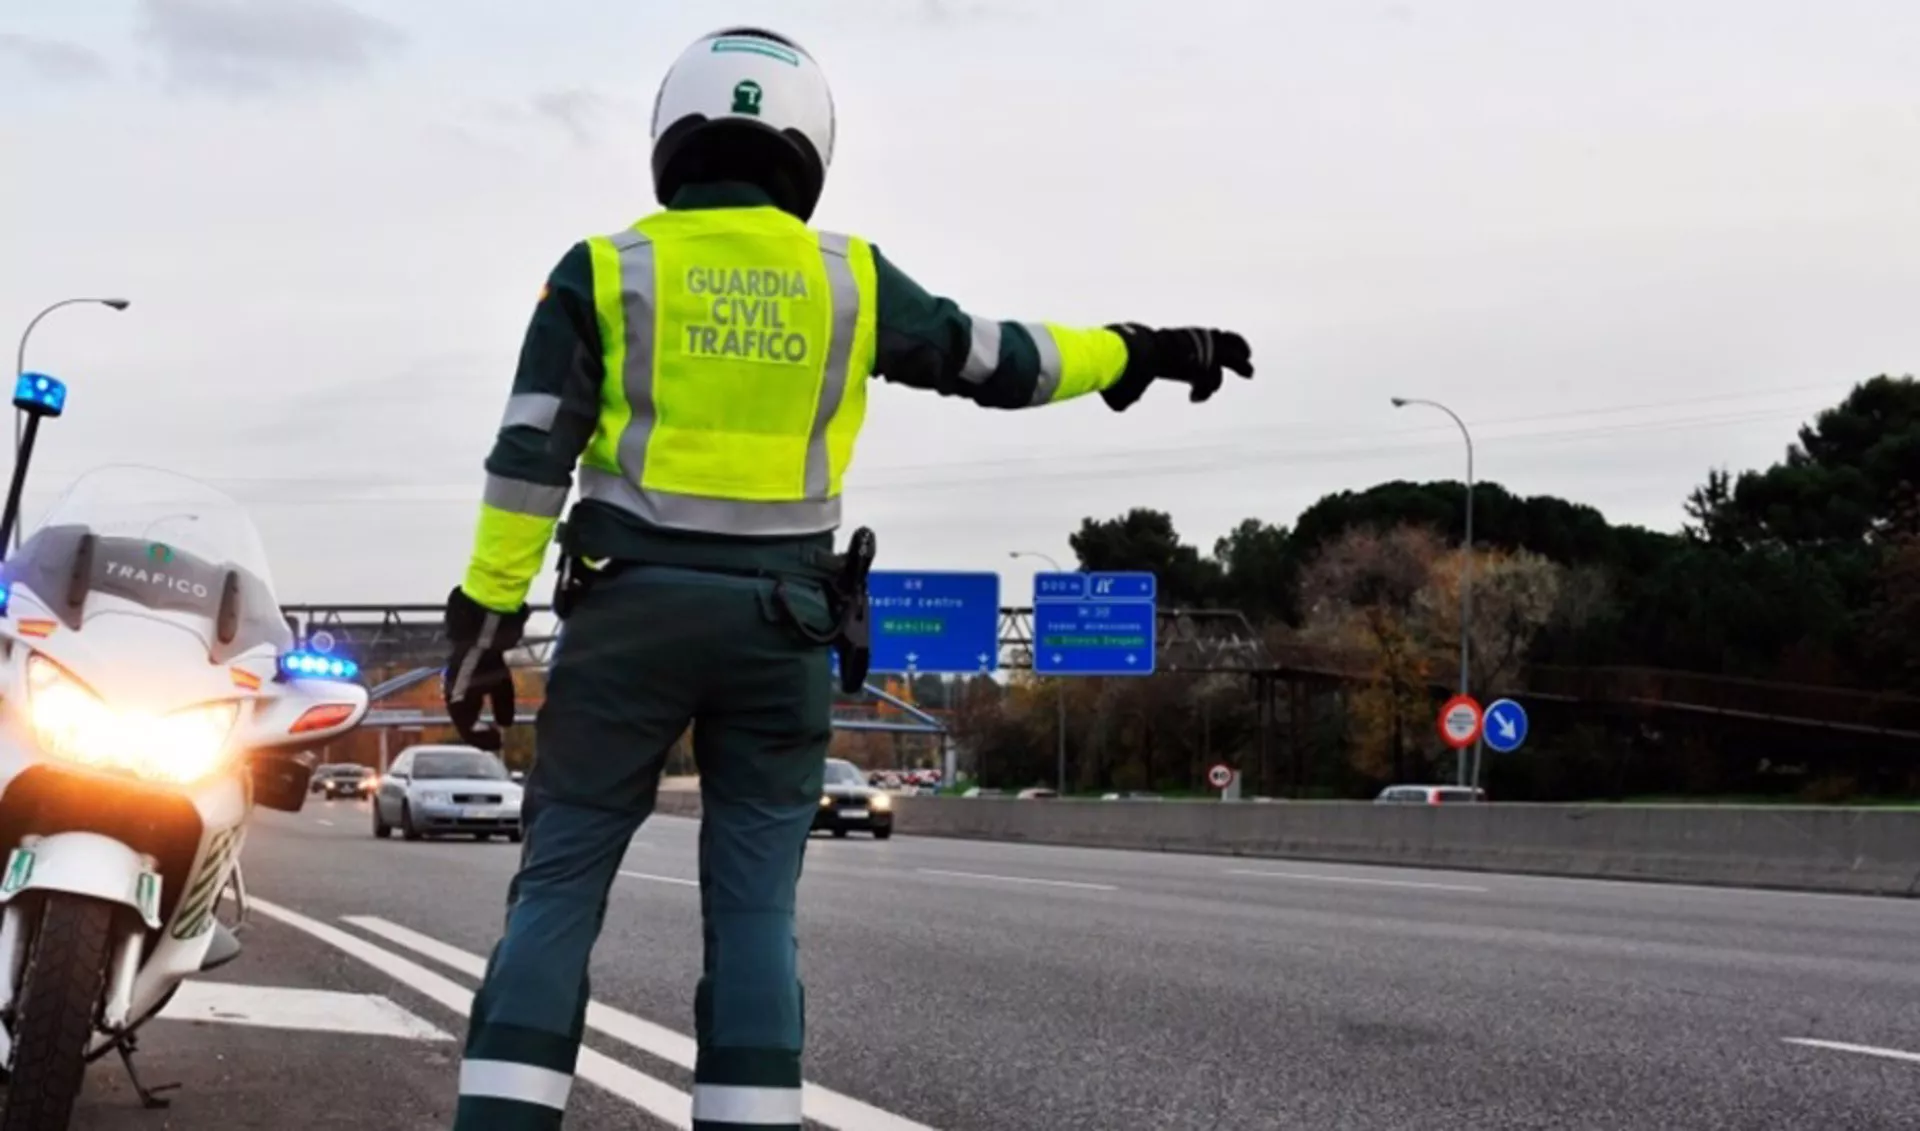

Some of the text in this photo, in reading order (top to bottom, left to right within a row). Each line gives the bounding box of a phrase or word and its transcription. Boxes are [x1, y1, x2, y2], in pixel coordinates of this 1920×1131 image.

[687, 266, 808, 297] GUARDIA
[712, 297, 785, 328] CIVIL
[686, 326, 807, 362] TRAFICO
[106, 560, 208, 598] TRAFICO
